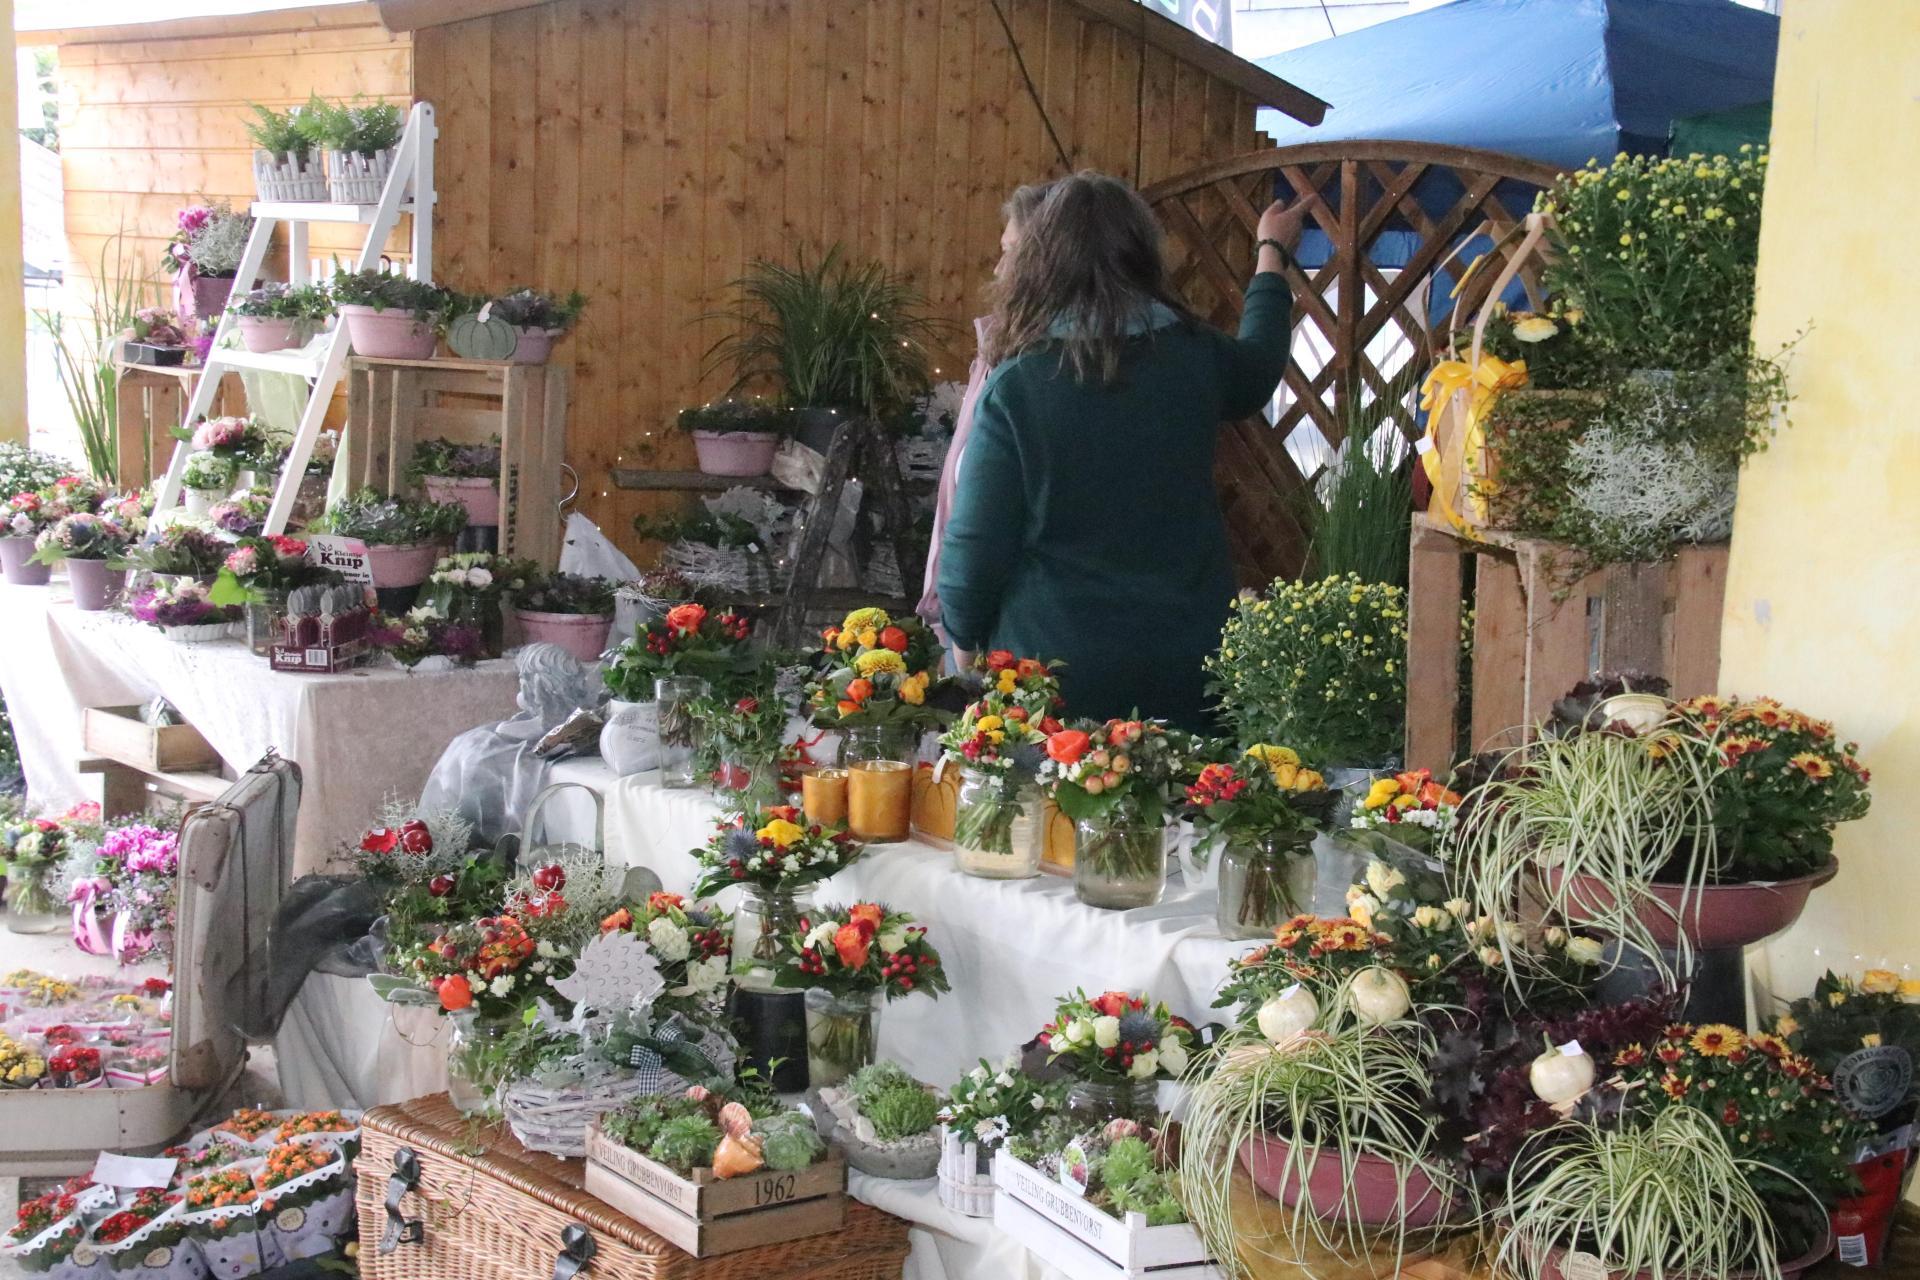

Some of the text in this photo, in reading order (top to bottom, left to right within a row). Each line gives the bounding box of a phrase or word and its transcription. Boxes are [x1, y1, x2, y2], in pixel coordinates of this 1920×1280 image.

[320, 552, 364, 570] Knip
[275, 652, 303, 665] Knip
[599, 1143, 683, 1203] VEILING GRUBBENVORST
[754, 1174, 796, 1206] 1962
[1016, 1172, 1103, 1240] VEILING GRUBBENVORST
